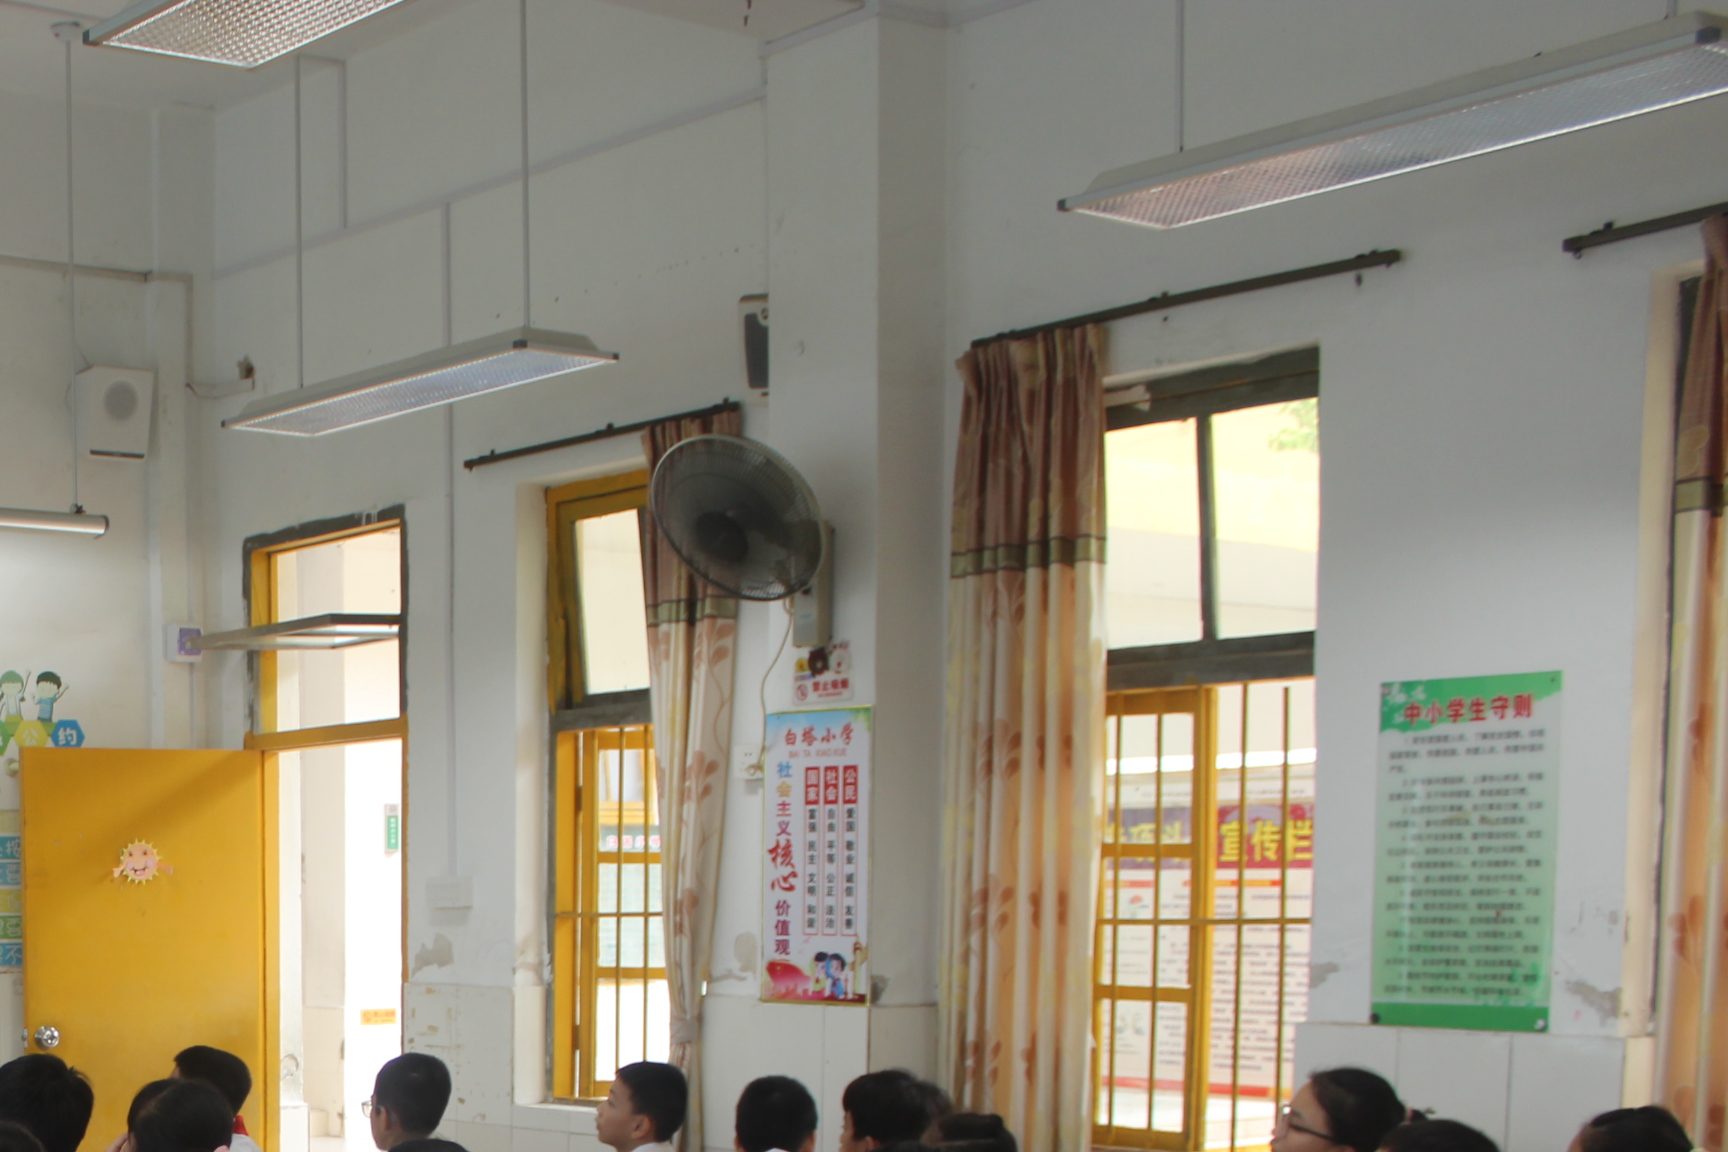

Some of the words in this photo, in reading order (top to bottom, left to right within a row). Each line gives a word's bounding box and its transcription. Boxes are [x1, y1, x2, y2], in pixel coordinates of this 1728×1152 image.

[1404, 693, 1533, 726] 中小学生守则
[784, 721, 854, 747] 白塔小学
[767, 761, 799, 956] 社会主义核心价值观
